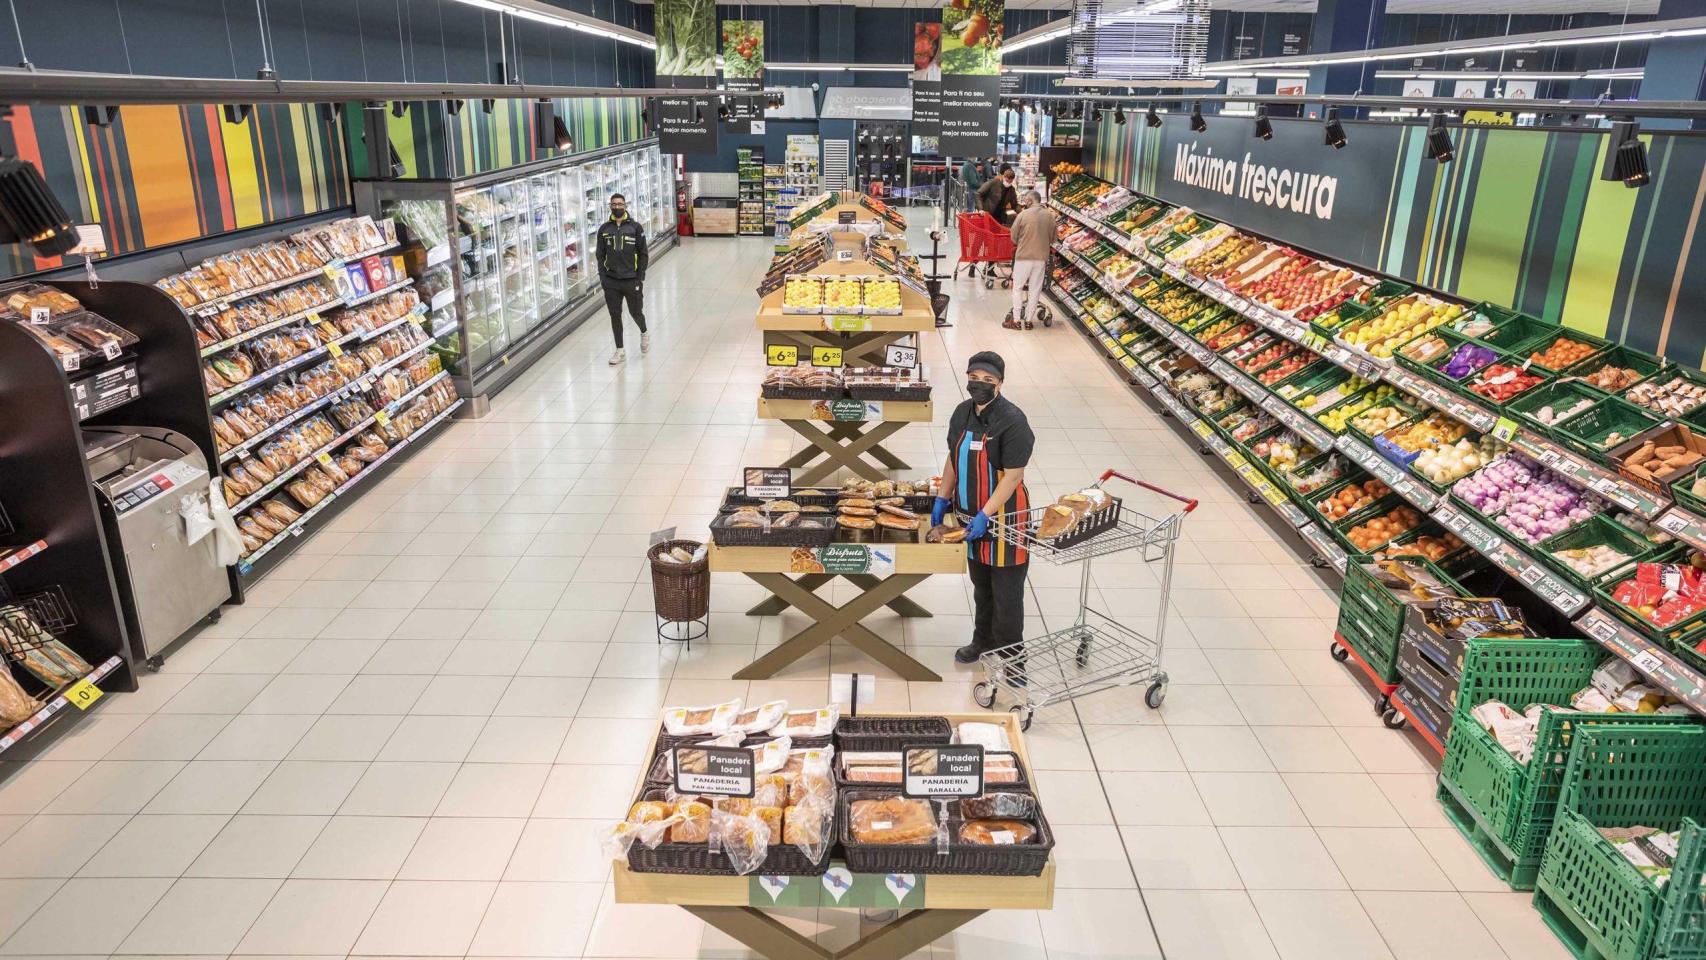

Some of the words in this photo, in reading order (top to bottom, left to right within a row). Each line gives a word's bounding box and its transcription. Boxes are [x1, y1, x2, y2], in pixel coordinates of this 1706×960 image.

[1174, 140, 1237, 196] Máxima
[1238, 152, 1338, 220] frescura
[826, 548, 863, 557] Disfruta
[1537, 584, 1557, 600] GALEG
[721, 766, 742, 774] local
[951, 764, 971, 772] local
